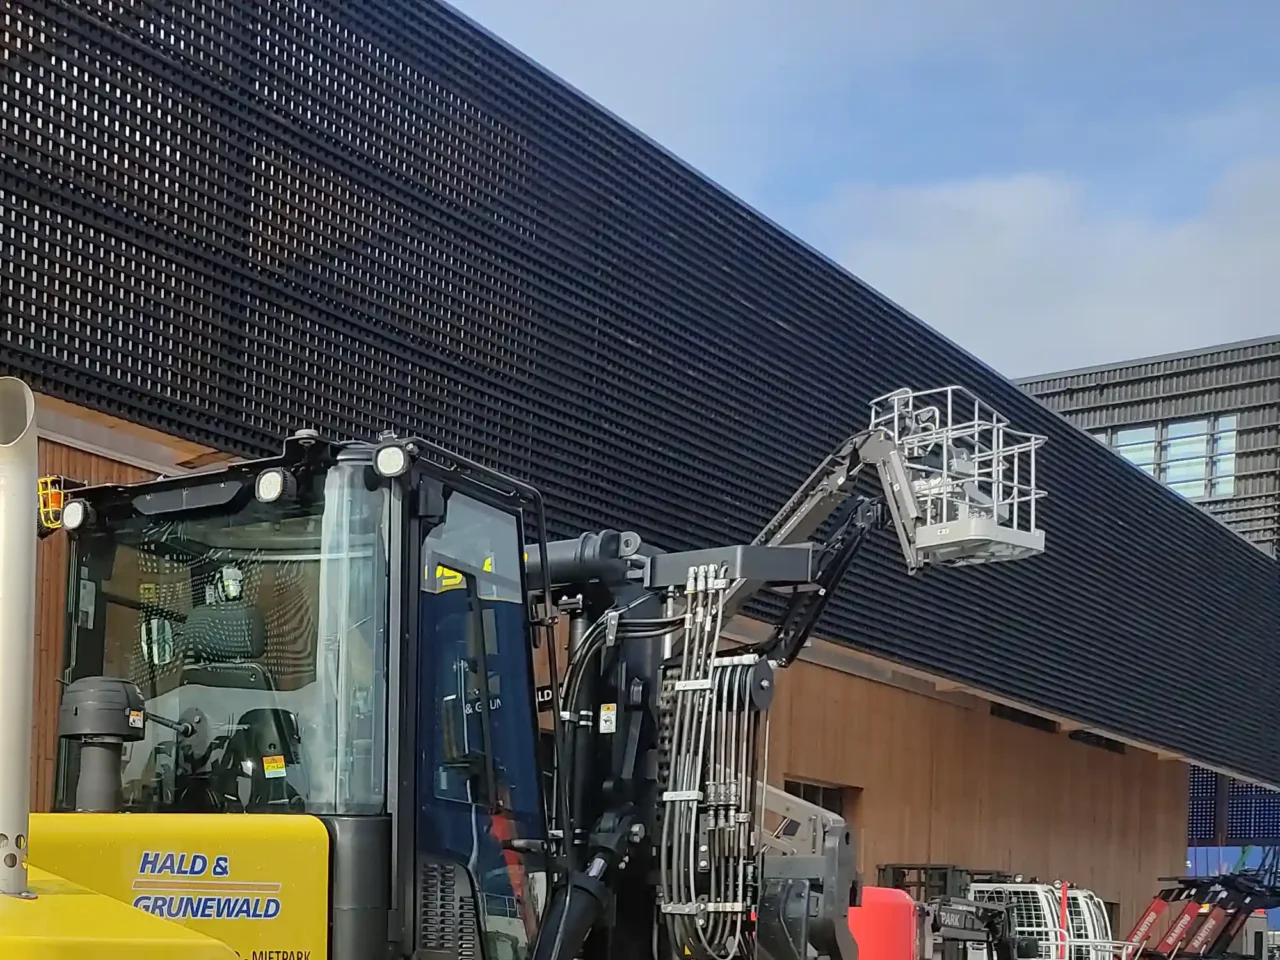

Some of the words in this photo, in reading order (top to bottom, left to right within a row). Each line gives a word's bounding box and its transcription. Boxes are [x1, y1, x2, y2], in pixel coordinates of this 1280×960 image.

[139, 851, 207, 875] HALD
[212, 856, 229, 877] &
[1166, 914, 1191, 945] MANITOU
